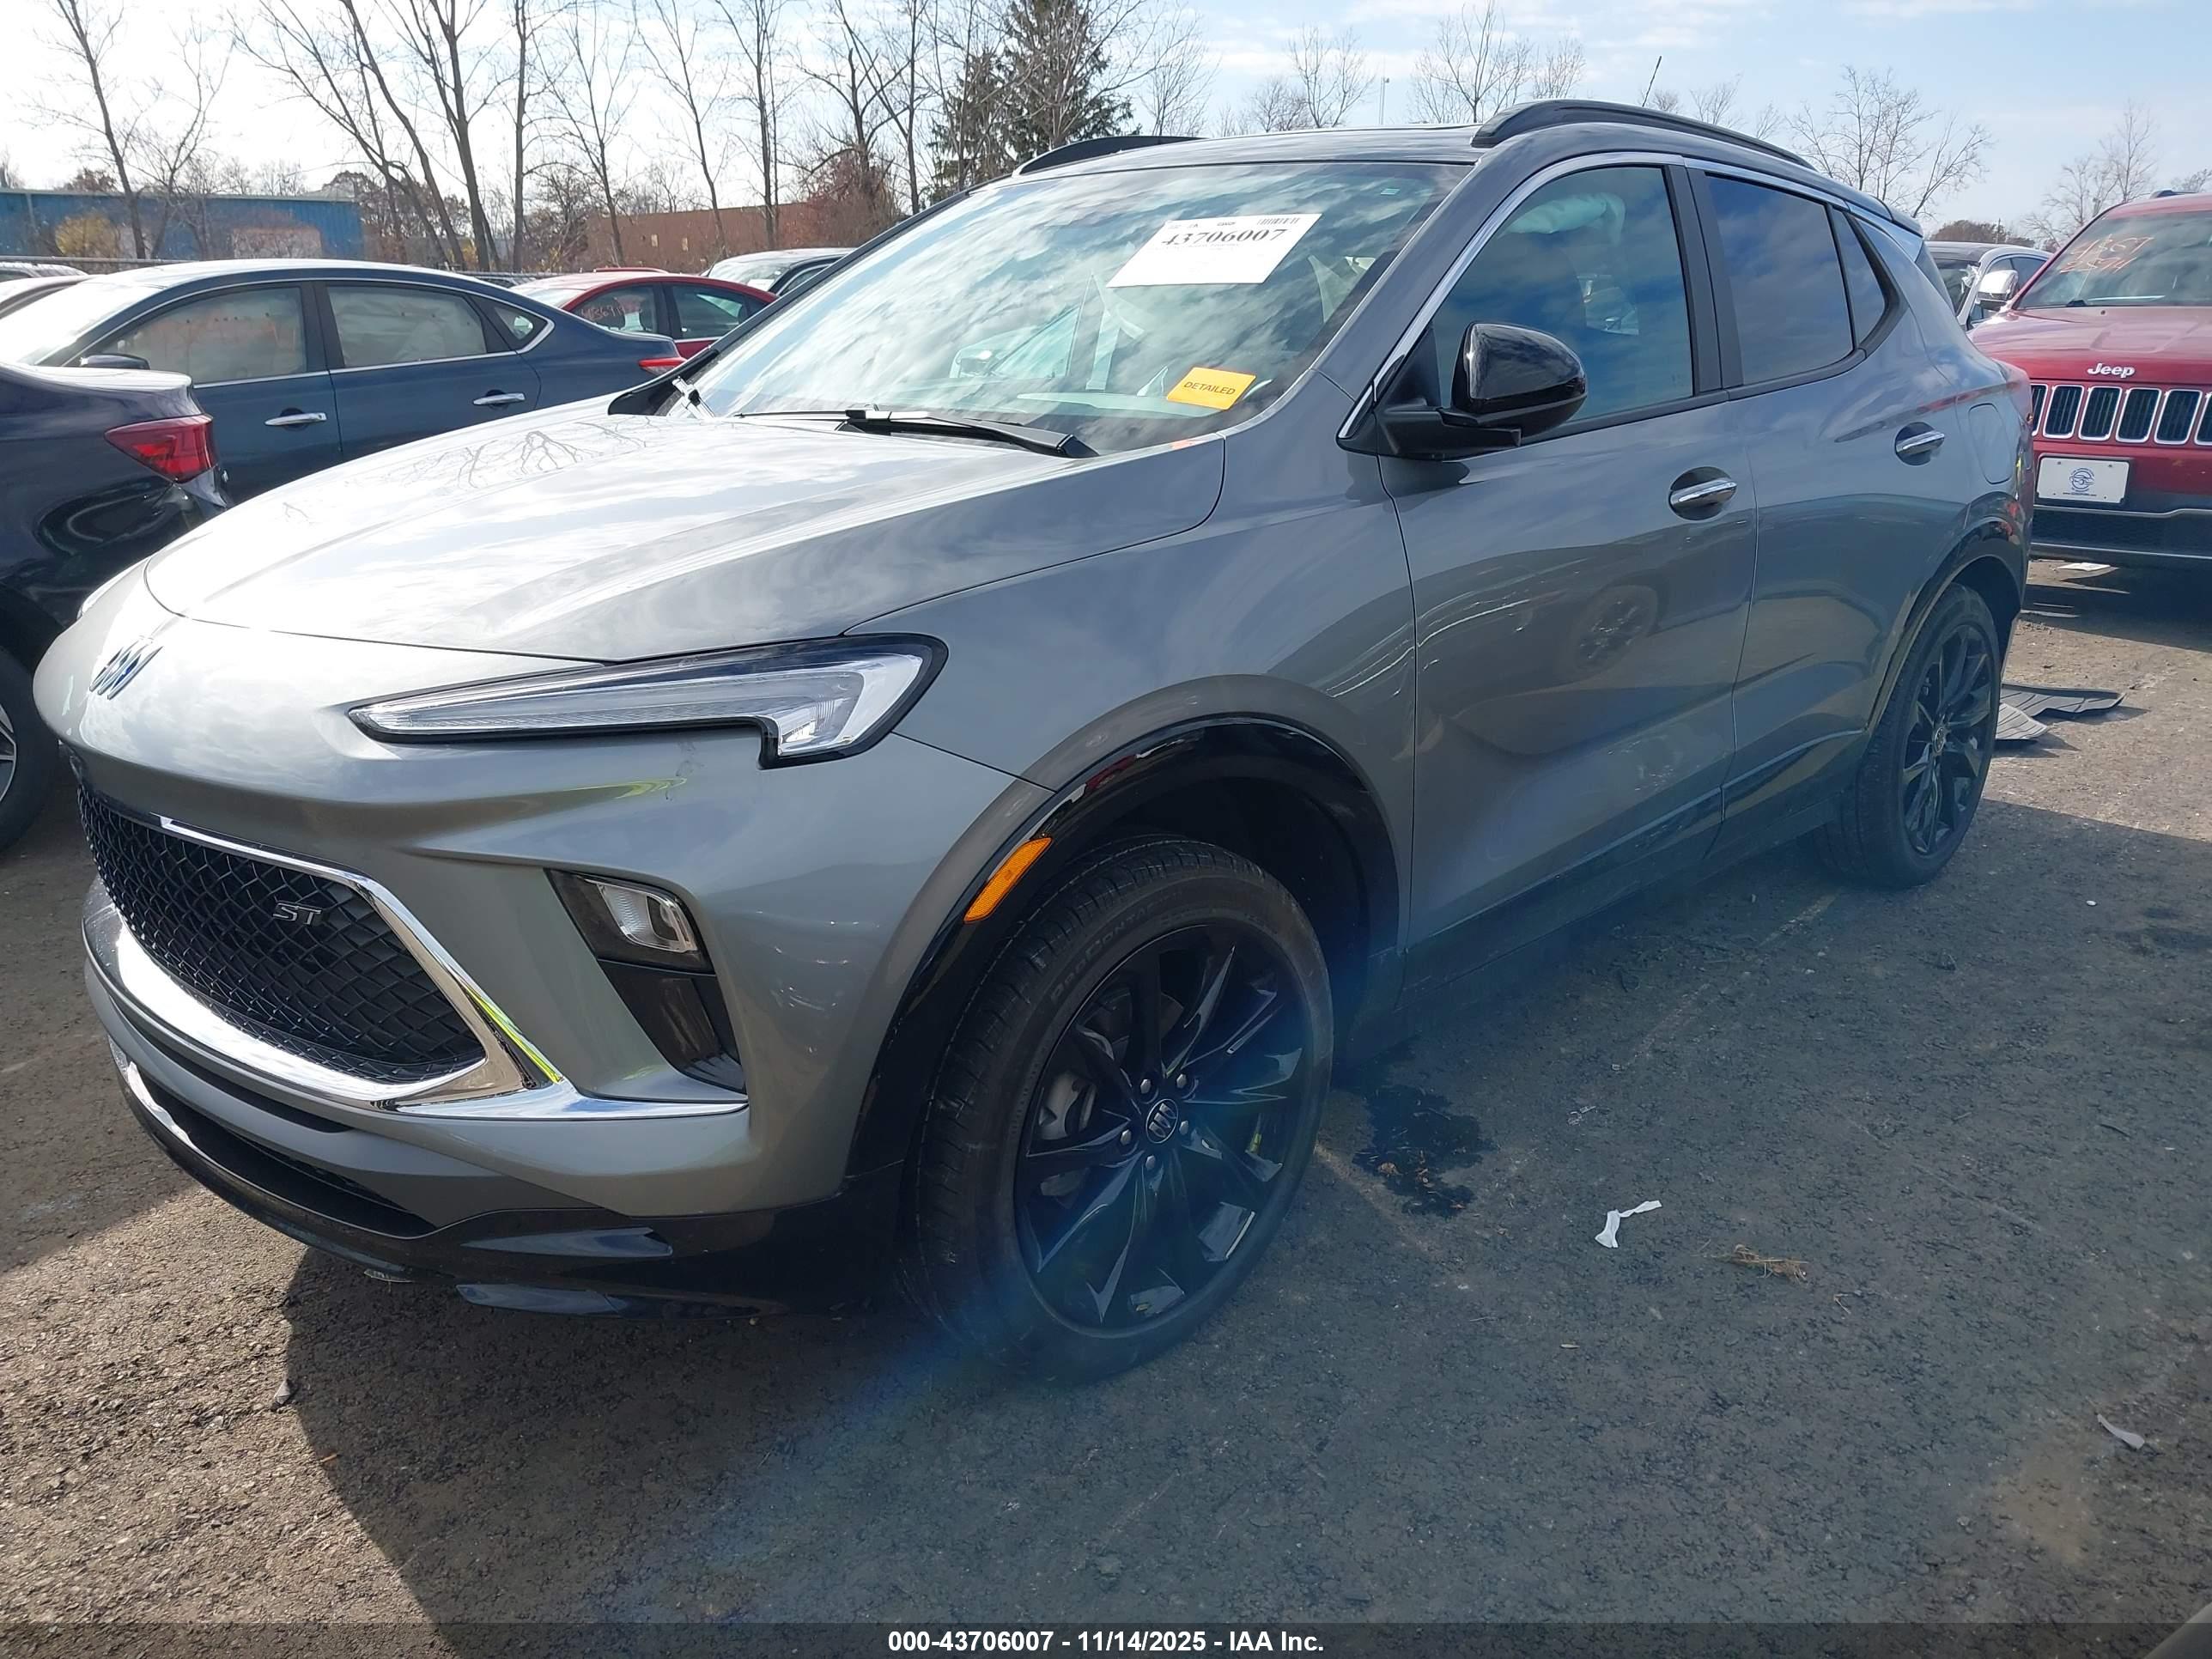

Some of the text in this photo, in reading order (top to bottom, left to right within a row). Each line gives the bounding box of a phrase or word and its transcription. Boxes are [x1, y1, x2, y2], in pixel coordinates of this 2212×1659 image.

[1162, 228, 1287, 246] 43706007
[2087, 363, 2136, 379] Jeep
[1182, 380, 1237, 396] DETAILED
[271, 902, 322, 925] ST
